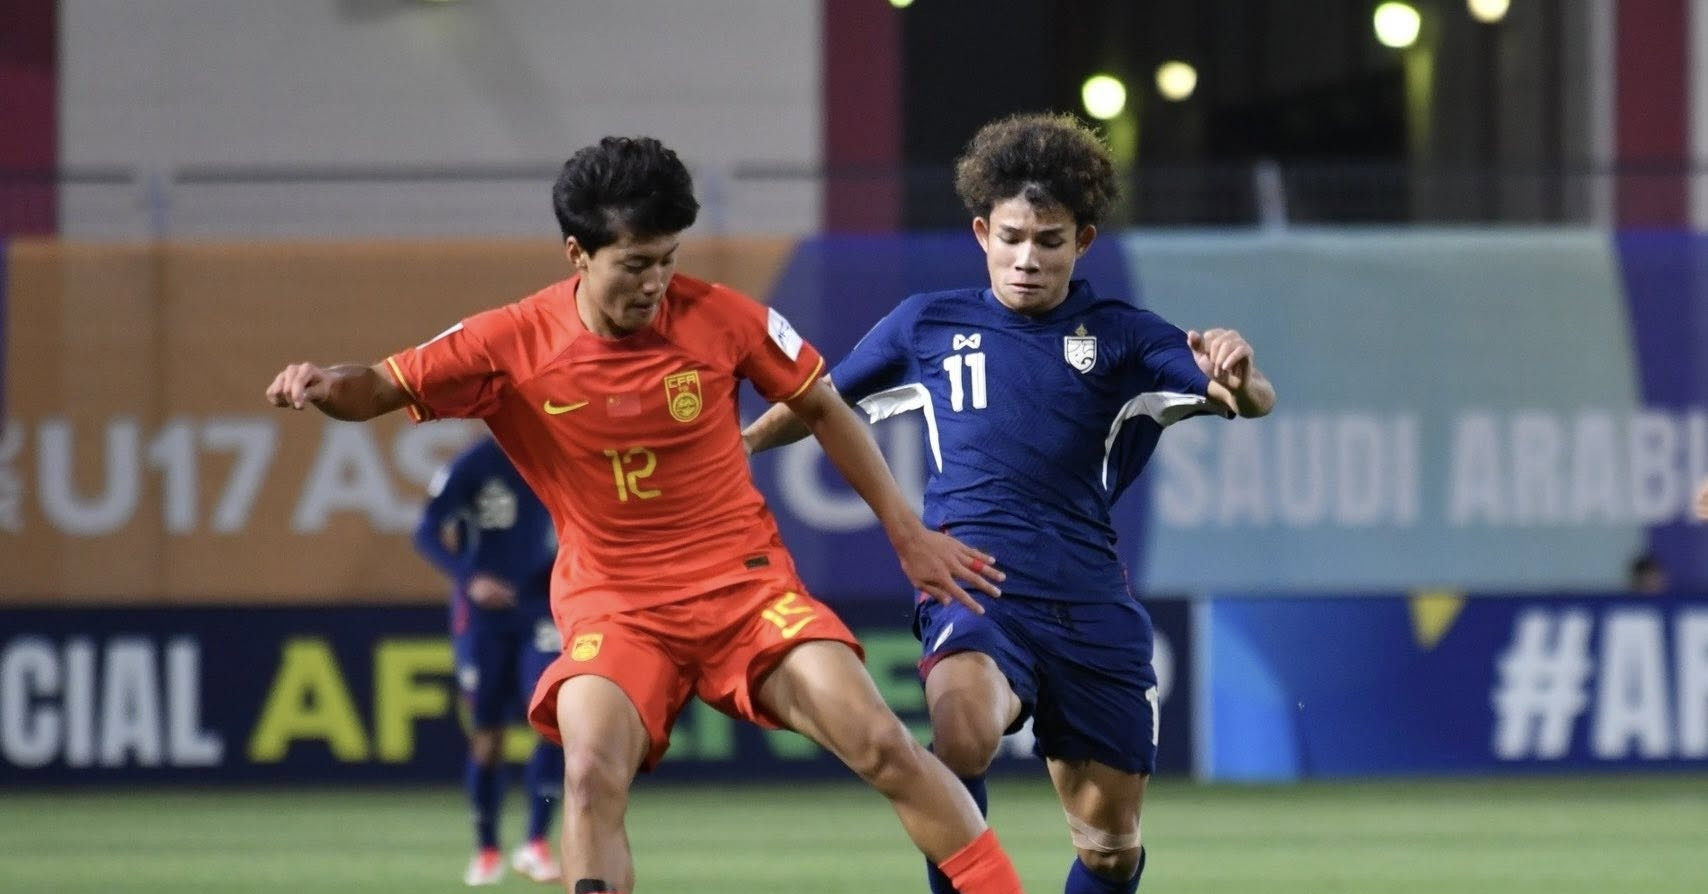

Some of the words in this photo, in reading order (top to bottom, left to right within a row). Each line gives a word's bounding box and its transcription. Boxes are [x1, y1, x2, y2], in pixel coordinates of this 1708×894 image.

[668, 374, 696, 388] CFA
[943, 352, 987, 412] 11
[36, 417, 279, 536] U17
[604, 447, 661, 502] 12
[1153, 412, 1422, 526] SAUDI
[0, 634, 223, 767] CIAL
